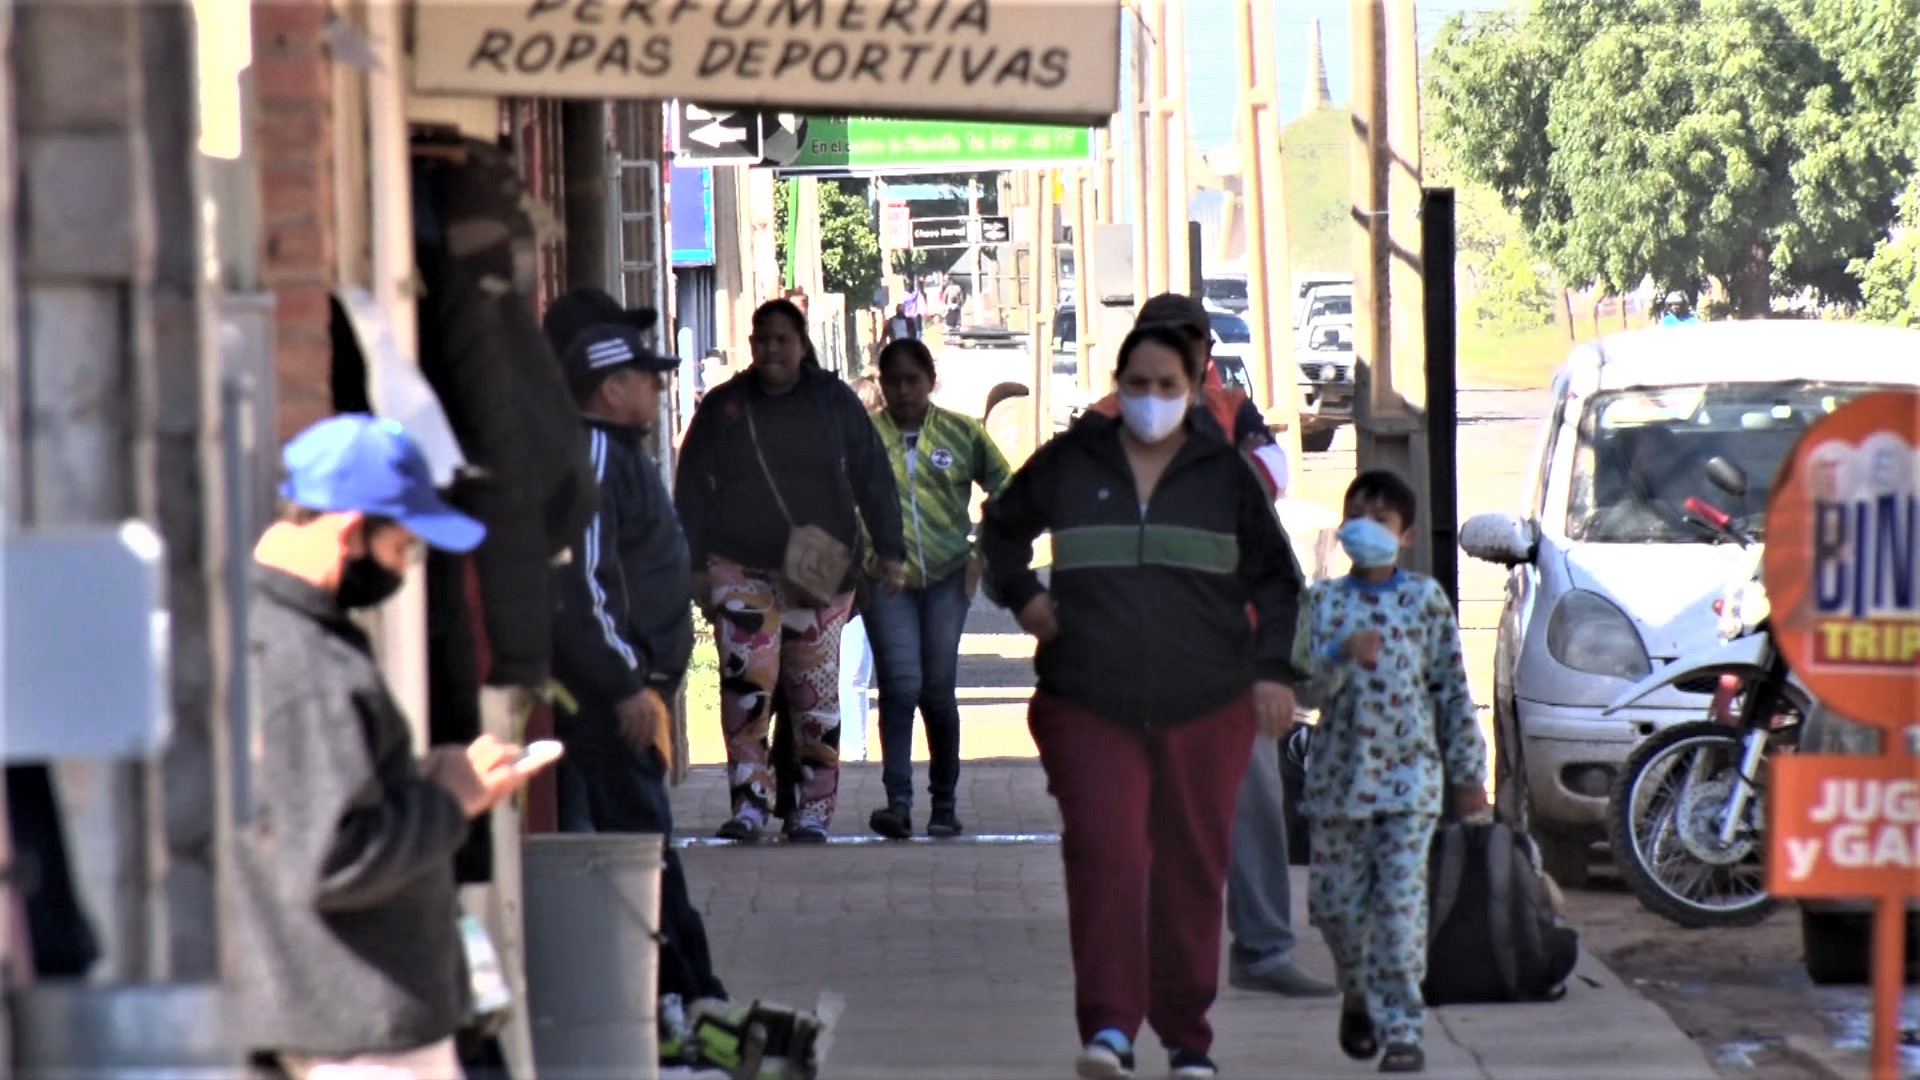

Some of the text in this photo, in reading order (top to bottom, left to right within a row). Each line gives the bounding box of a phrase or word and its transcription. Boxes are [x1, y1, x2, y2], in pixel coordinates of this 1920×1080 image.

[467, 31, 1071, 89] ROPAS DEPORTIVAS
[1821, 622, 1920, 661] TRIP
[1808, 778, 1920, 822] JUG
[1783, 824, 1920, 881] y GA
